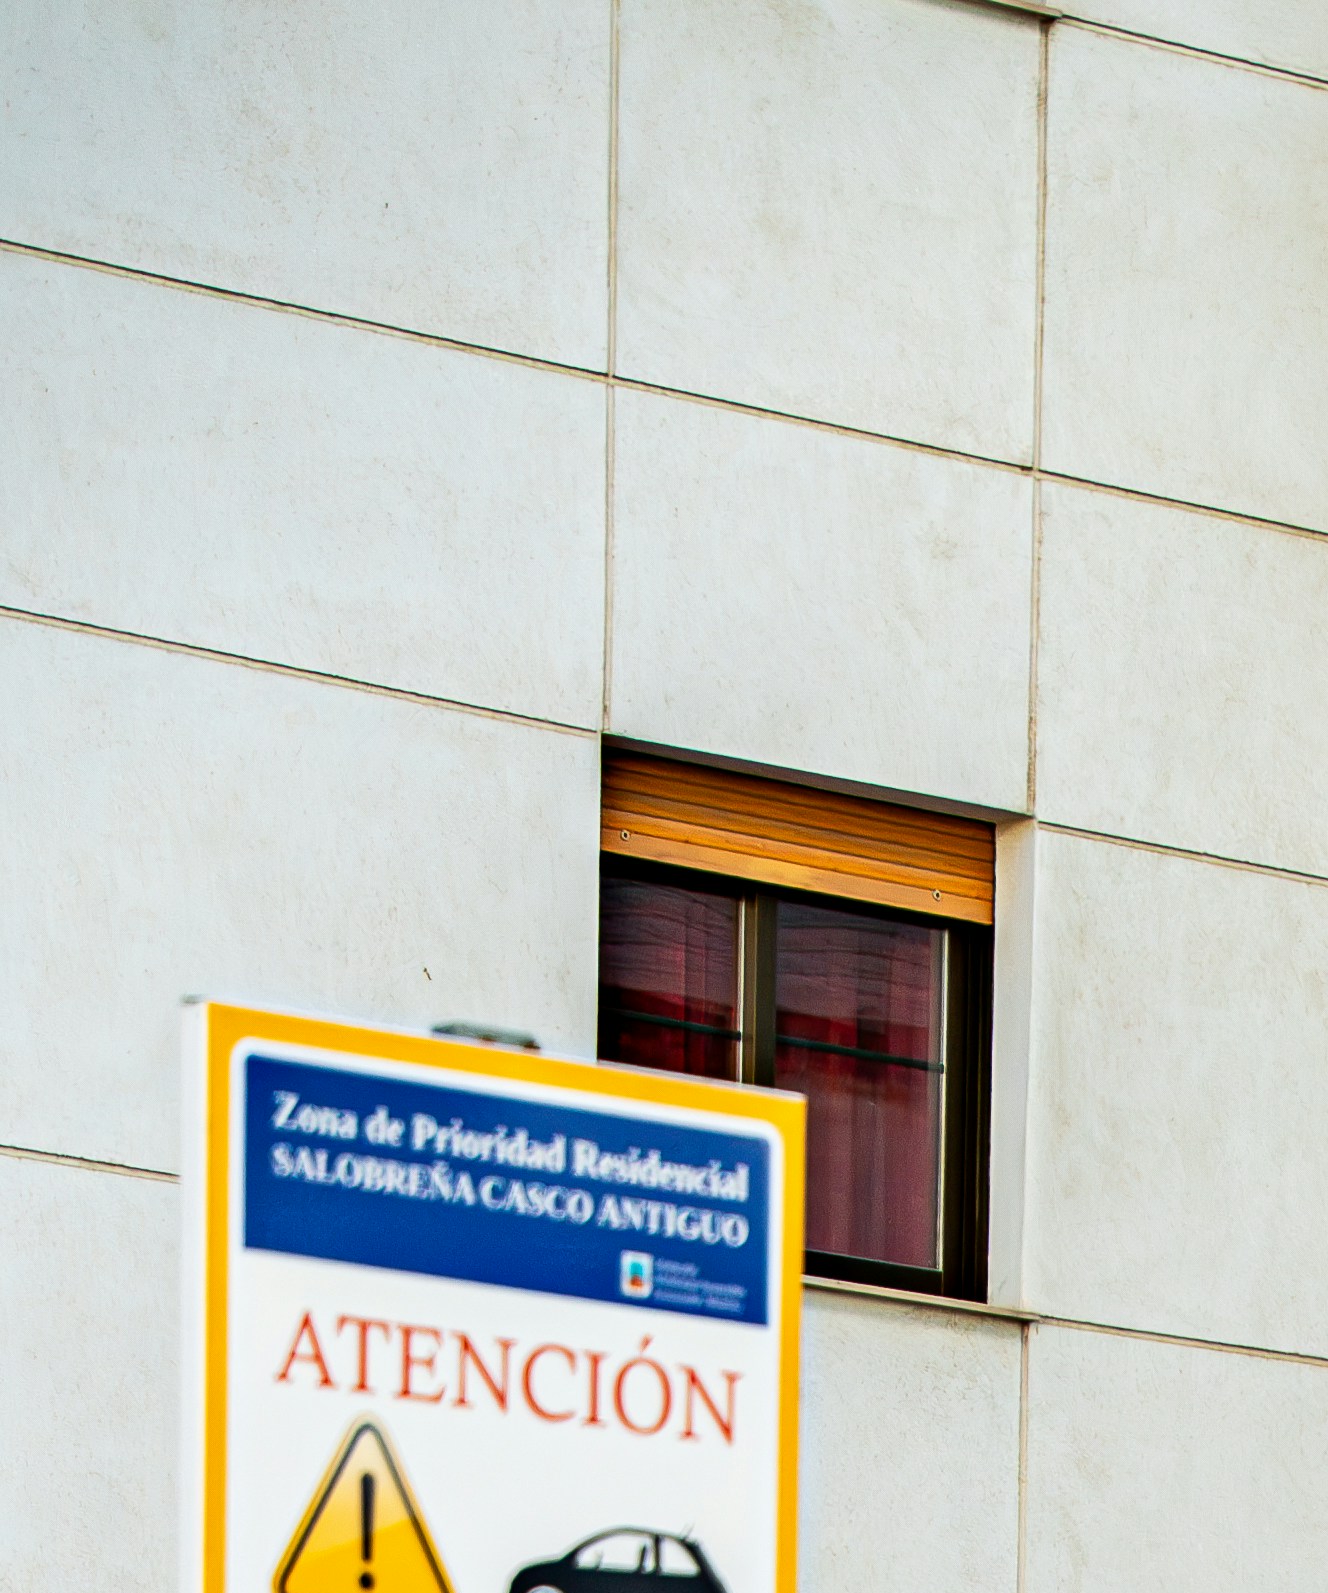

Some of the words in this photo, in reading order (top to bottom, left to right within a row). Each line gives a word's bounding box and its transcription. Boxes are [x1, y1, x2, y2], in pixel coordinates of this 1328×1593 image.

[270, 1142, 475, 1205] SALOBREÑA
[479, 1175, 594, 1224] CASCO
[597, 1193, 750, 1248] ANTIGUO
[271, 1090, 359, 1140] Zona
[364, 1104, 405, 1146] de
[410, 1112, 567, 1174] Prioridad
[571, 1135, 750, 1202] Residencial
[273, 1309, 743, 1446] ATENCIÓN
